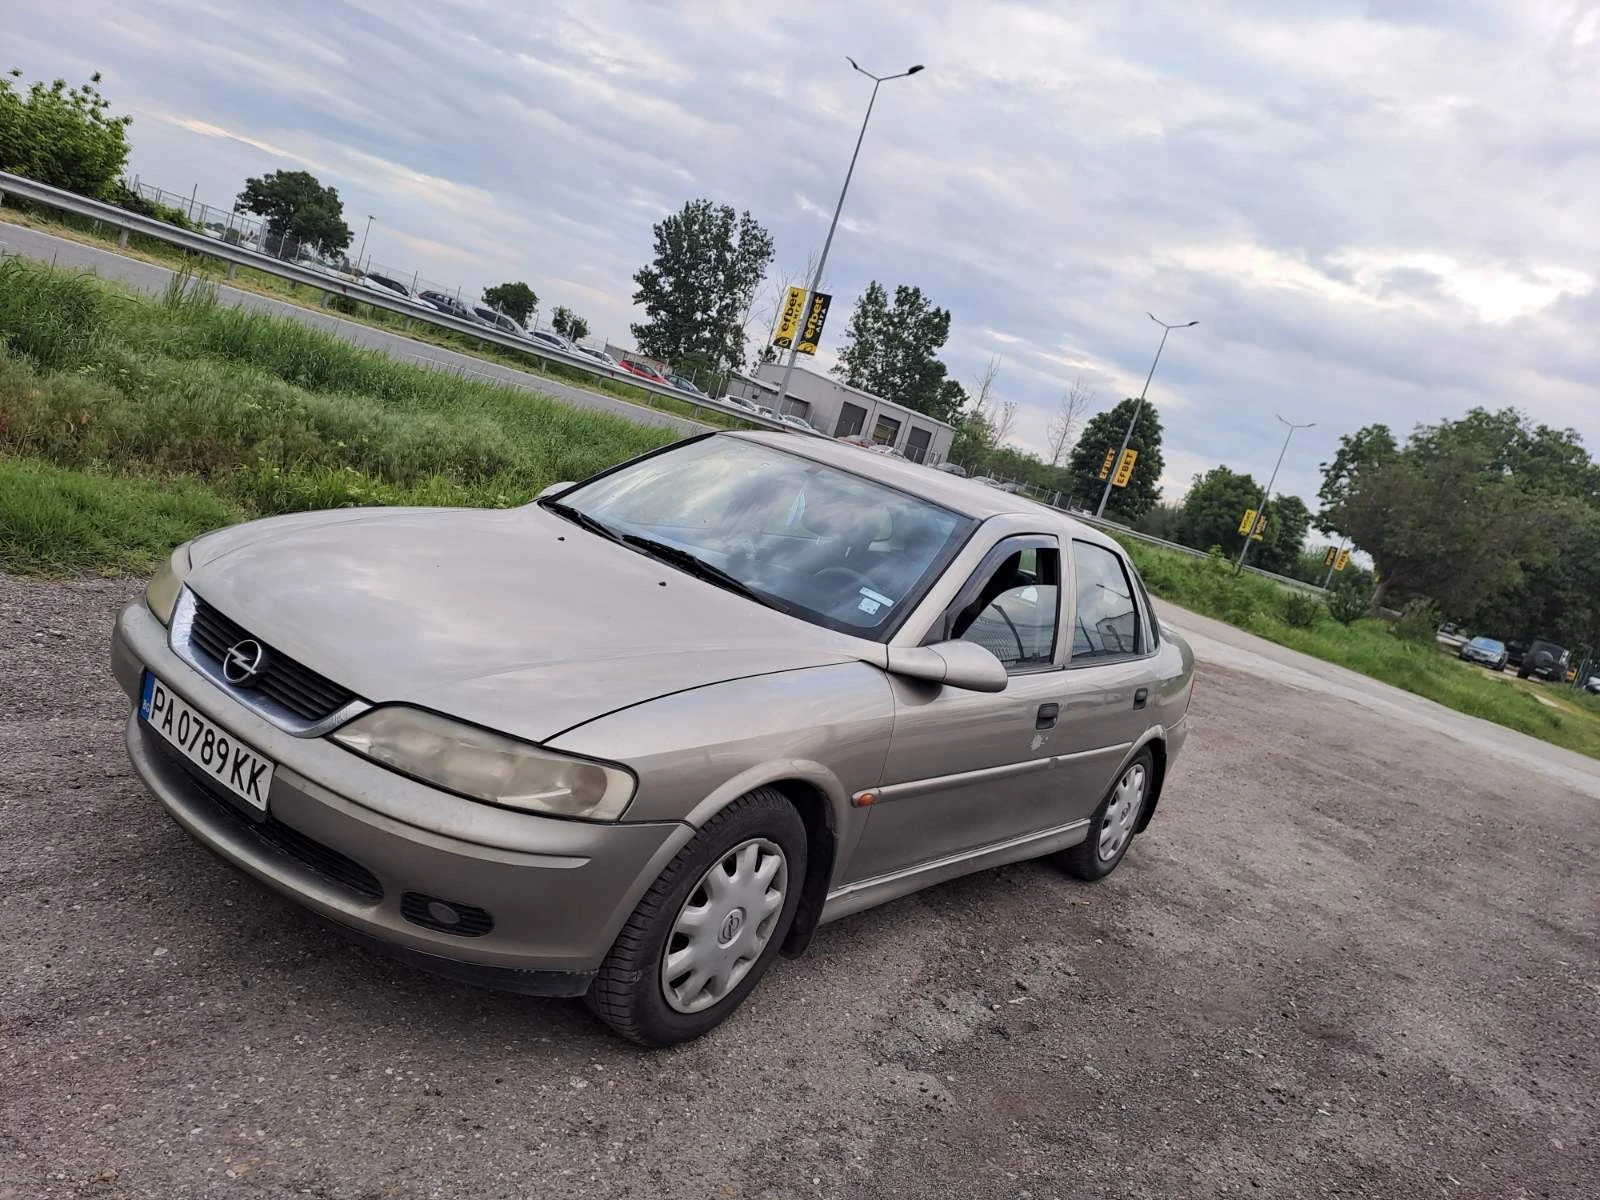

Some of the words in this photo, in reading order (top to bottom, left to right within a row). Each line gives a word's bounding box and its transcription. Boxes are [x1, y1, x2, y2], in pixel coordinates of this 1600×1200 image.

[781, 290, 799, 332] efbet
[804, 296, 824, 339] efbet
[1117, 452, 1132, 484] EFBET
